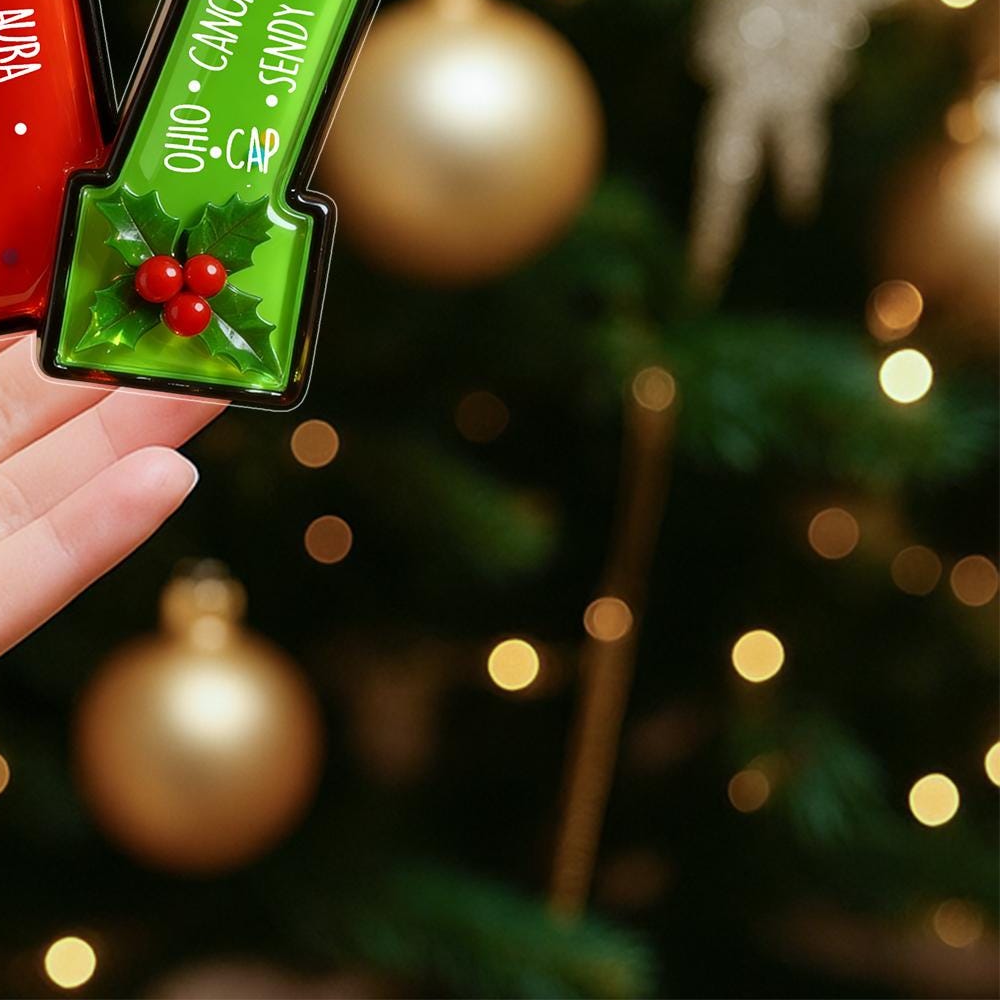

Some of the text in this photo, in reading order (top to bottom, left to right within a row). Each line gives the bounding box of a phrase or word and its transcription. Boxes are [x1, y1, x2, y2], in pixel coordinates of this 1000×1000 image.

[258, 3, 317, 94] SENDY
[164, 103, 211, 173] OHIO
[226, 127, 280, 173] CAP
